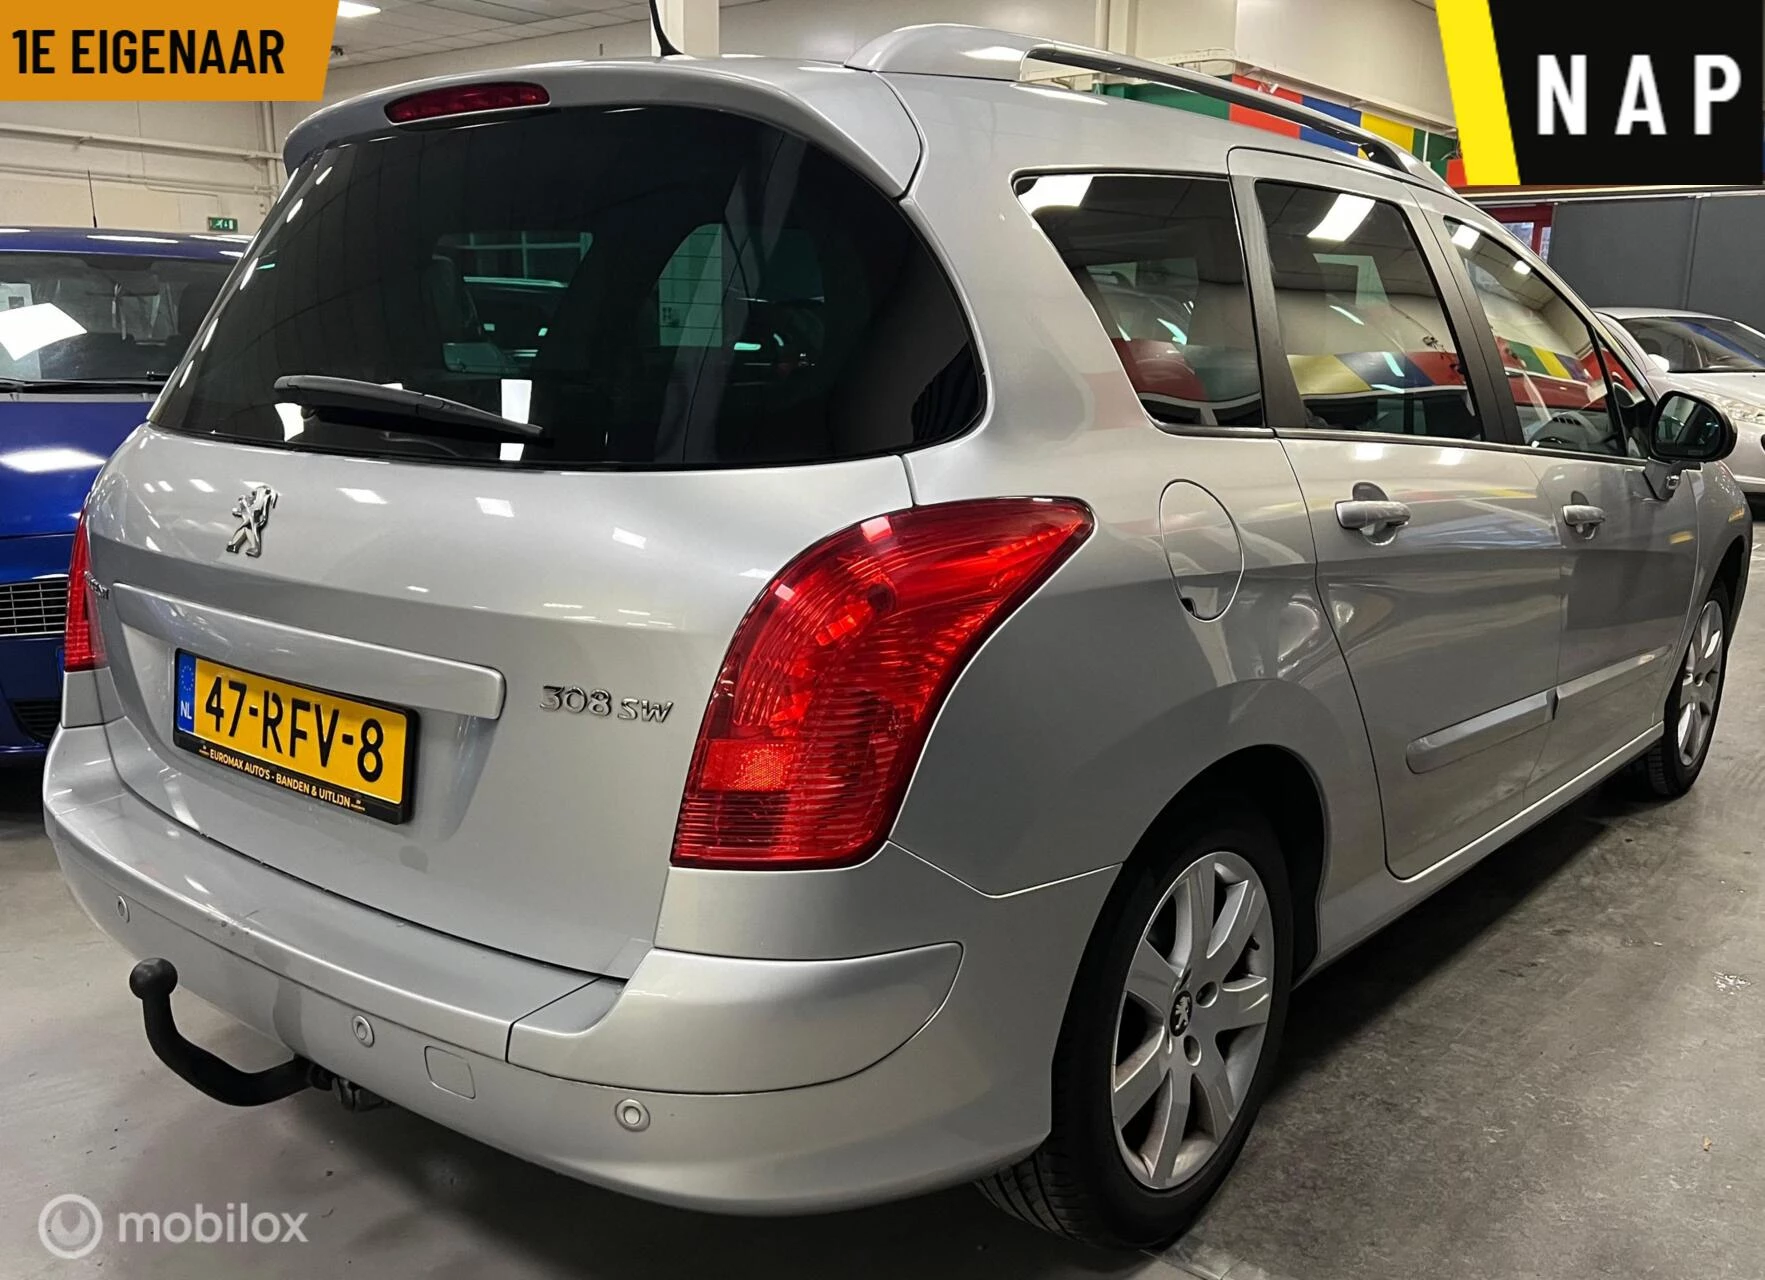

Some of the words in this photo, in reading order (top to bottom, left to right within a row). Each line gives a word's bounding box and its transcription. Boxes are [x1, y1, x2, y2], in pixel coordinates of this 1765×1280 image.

[180, 700, 193, 720] NL
[540, 685, 612, 717] 308
[617, 698, 674, 723] SW
[205, 676, 384, 783] 47-RFV-8
[209, 748, 244, 770] EUROMAX
[244, 762, 271, 780] AUTO'S
[276, 773, 310, 794] BANDEN
[311, 785, 318, 797] &
[319, 787, 351, 808] UITLIJN
